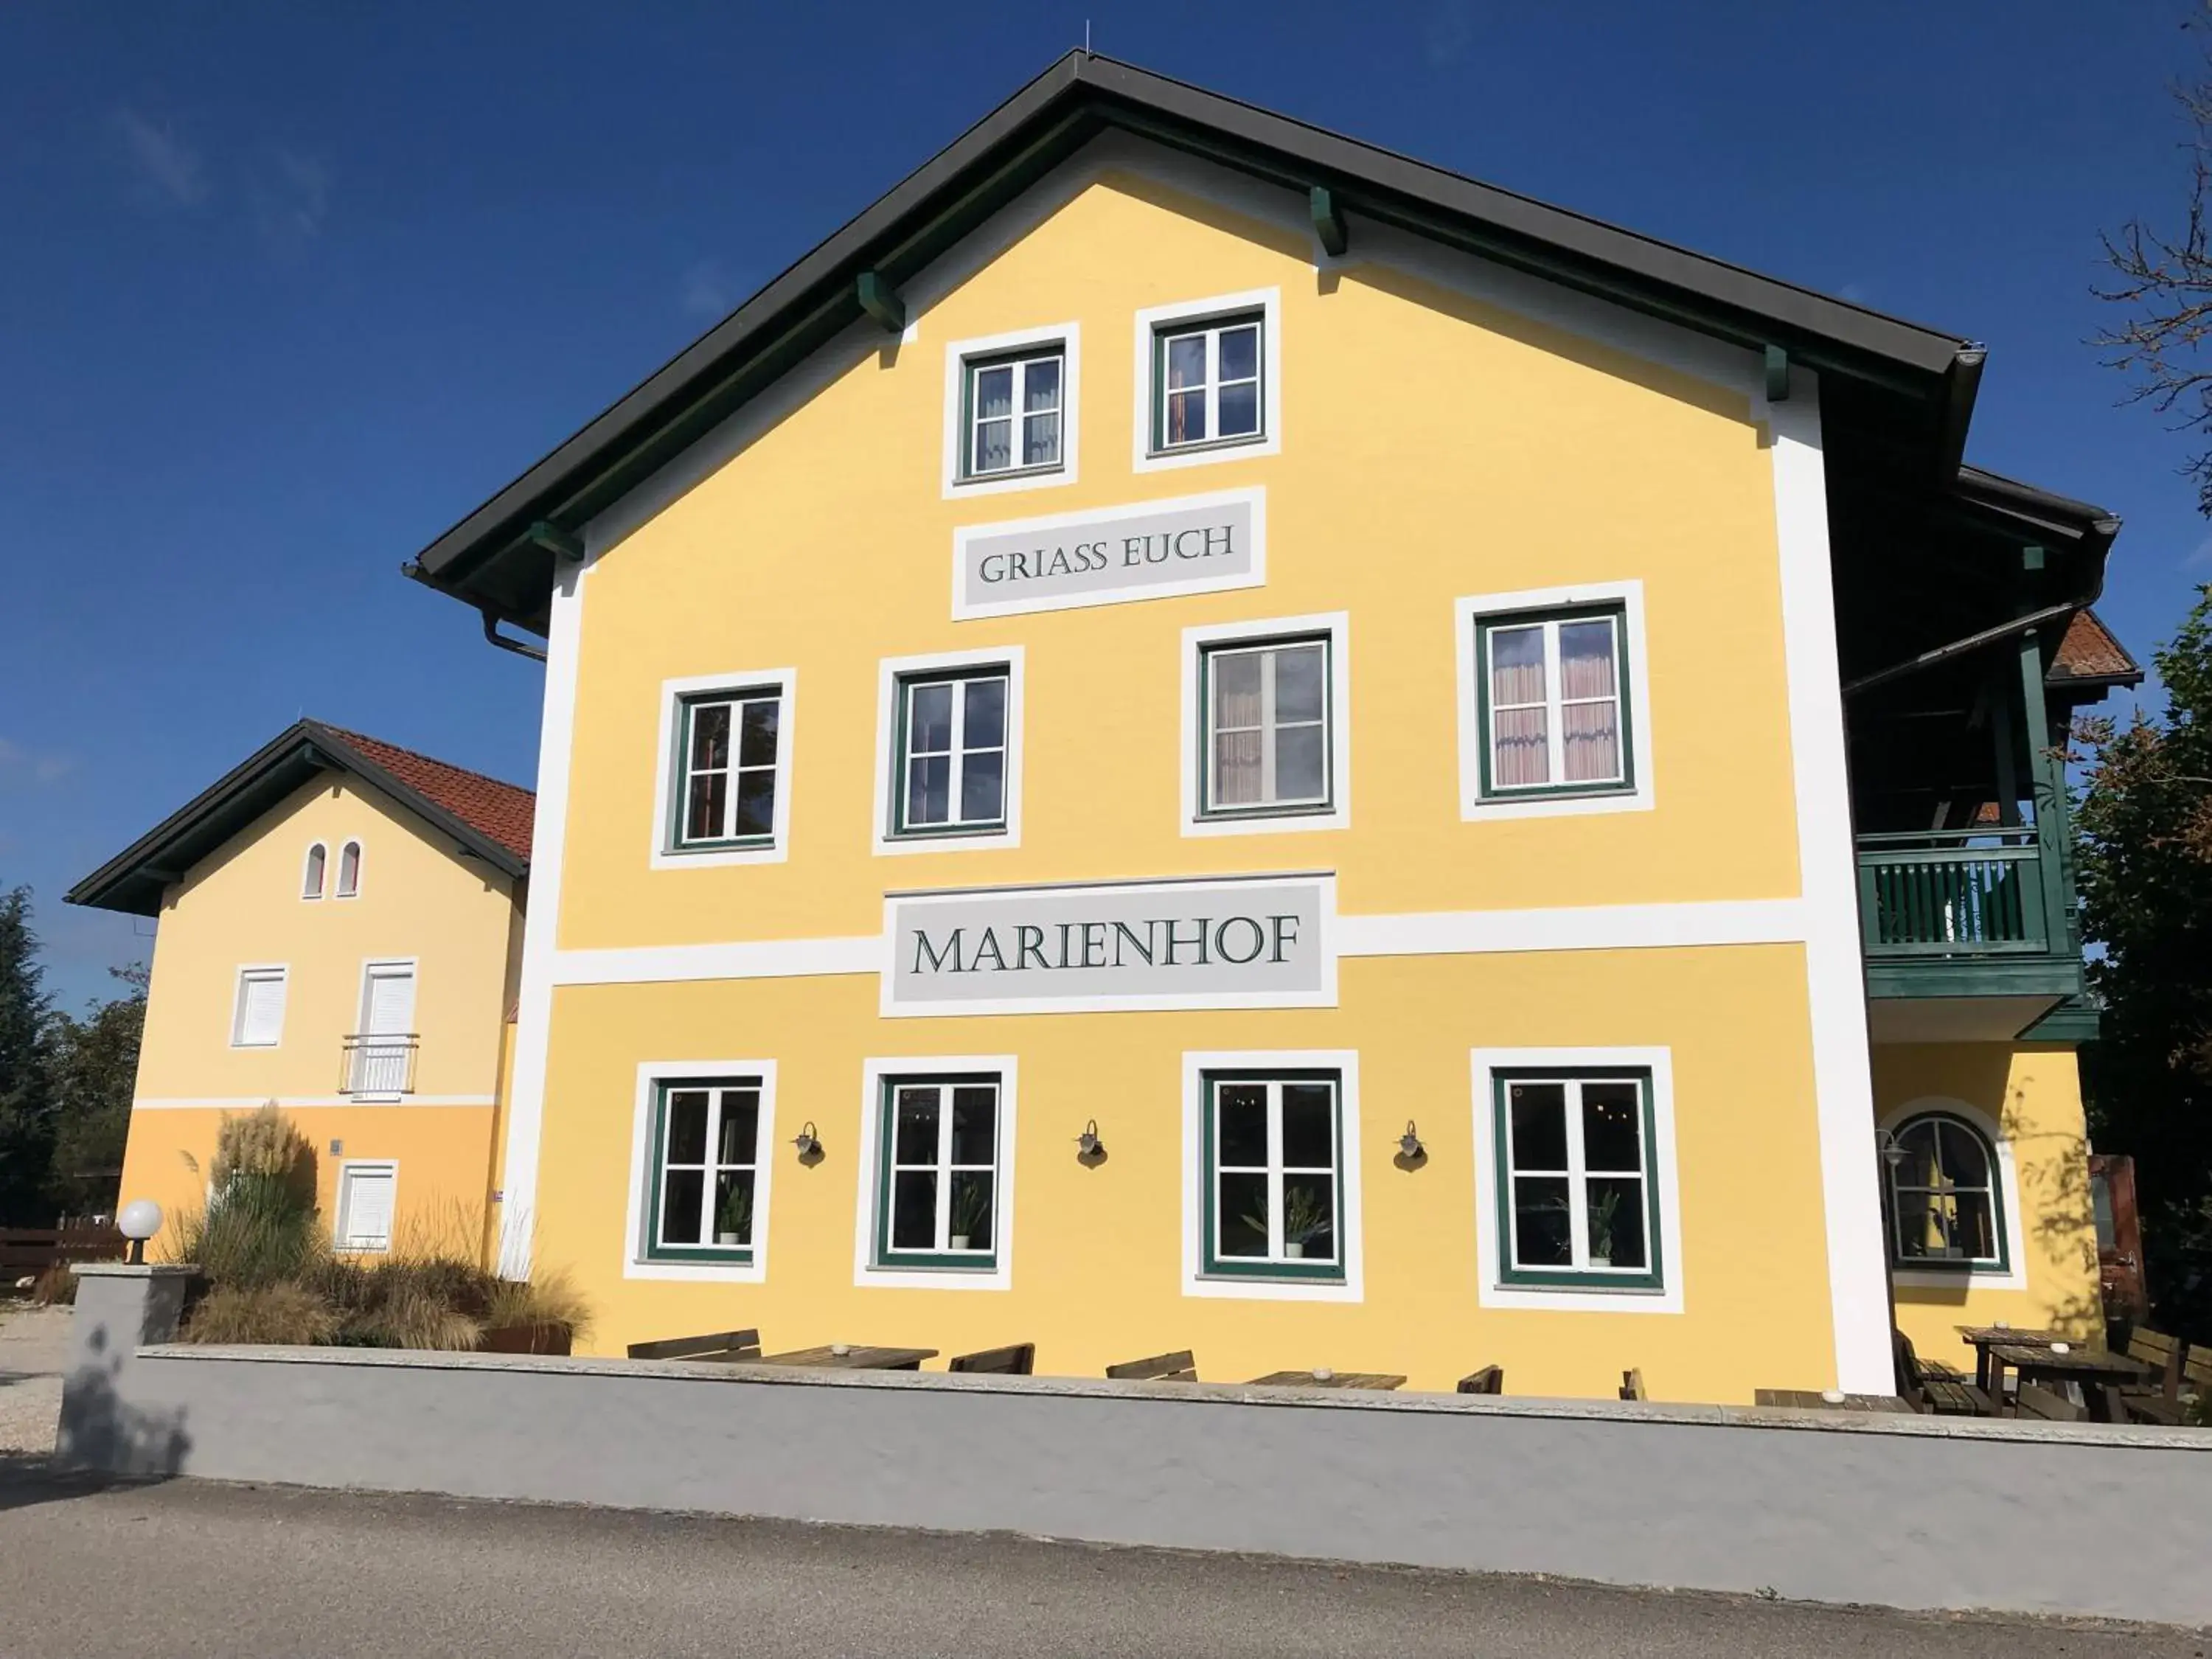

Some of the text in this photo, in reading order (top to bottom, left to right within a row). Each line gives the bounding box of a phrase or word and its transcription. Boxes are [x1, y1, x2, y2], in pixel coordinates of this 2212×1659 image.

[979, 525, 1234, 584] GRIASS EUCH
[911, 916, 1300, 974] MARIENHOF
